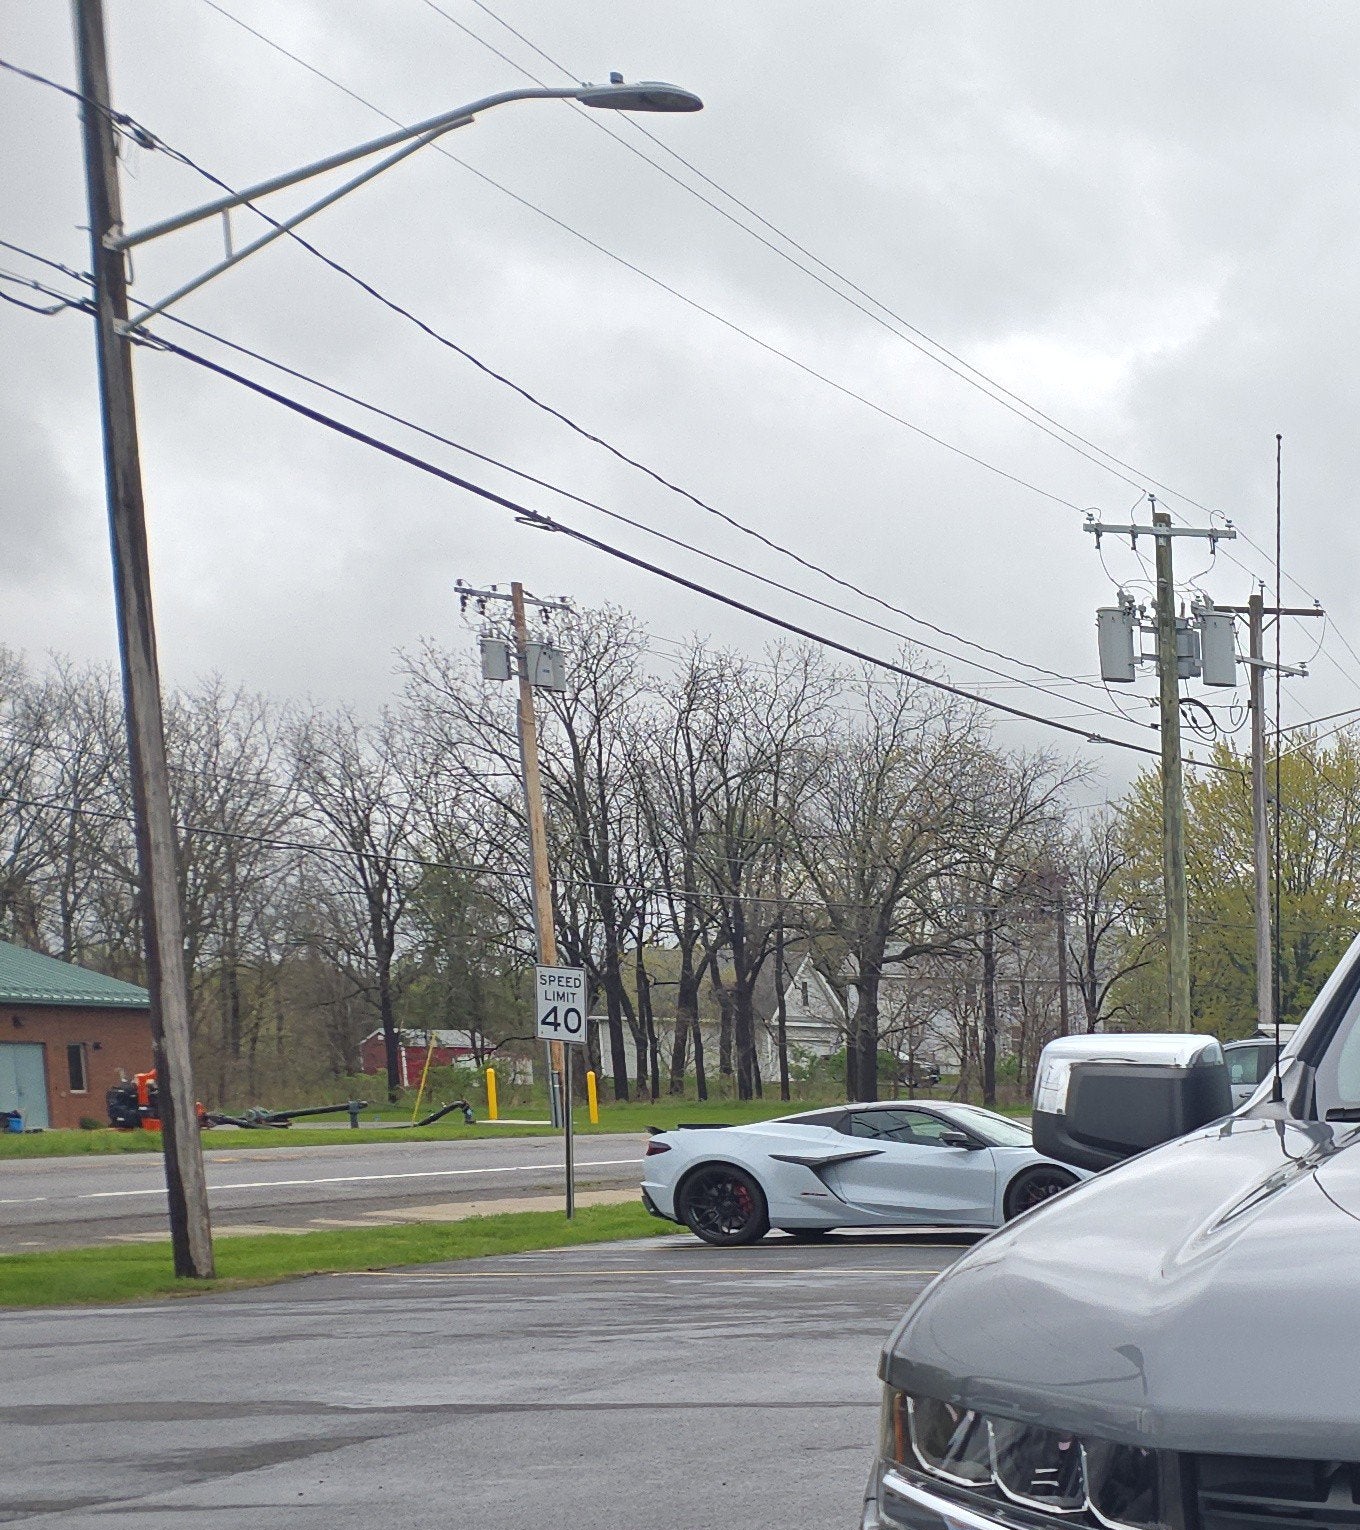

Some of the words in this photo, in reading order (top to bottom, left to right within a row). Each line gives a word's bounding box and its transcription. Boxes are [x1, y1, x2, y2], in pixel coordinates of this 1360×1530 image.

[540, 974, 581, 988] SPEED
[544, 990, 576, 1003] LIMIT
[541, 1006, 581, 1033] 40
